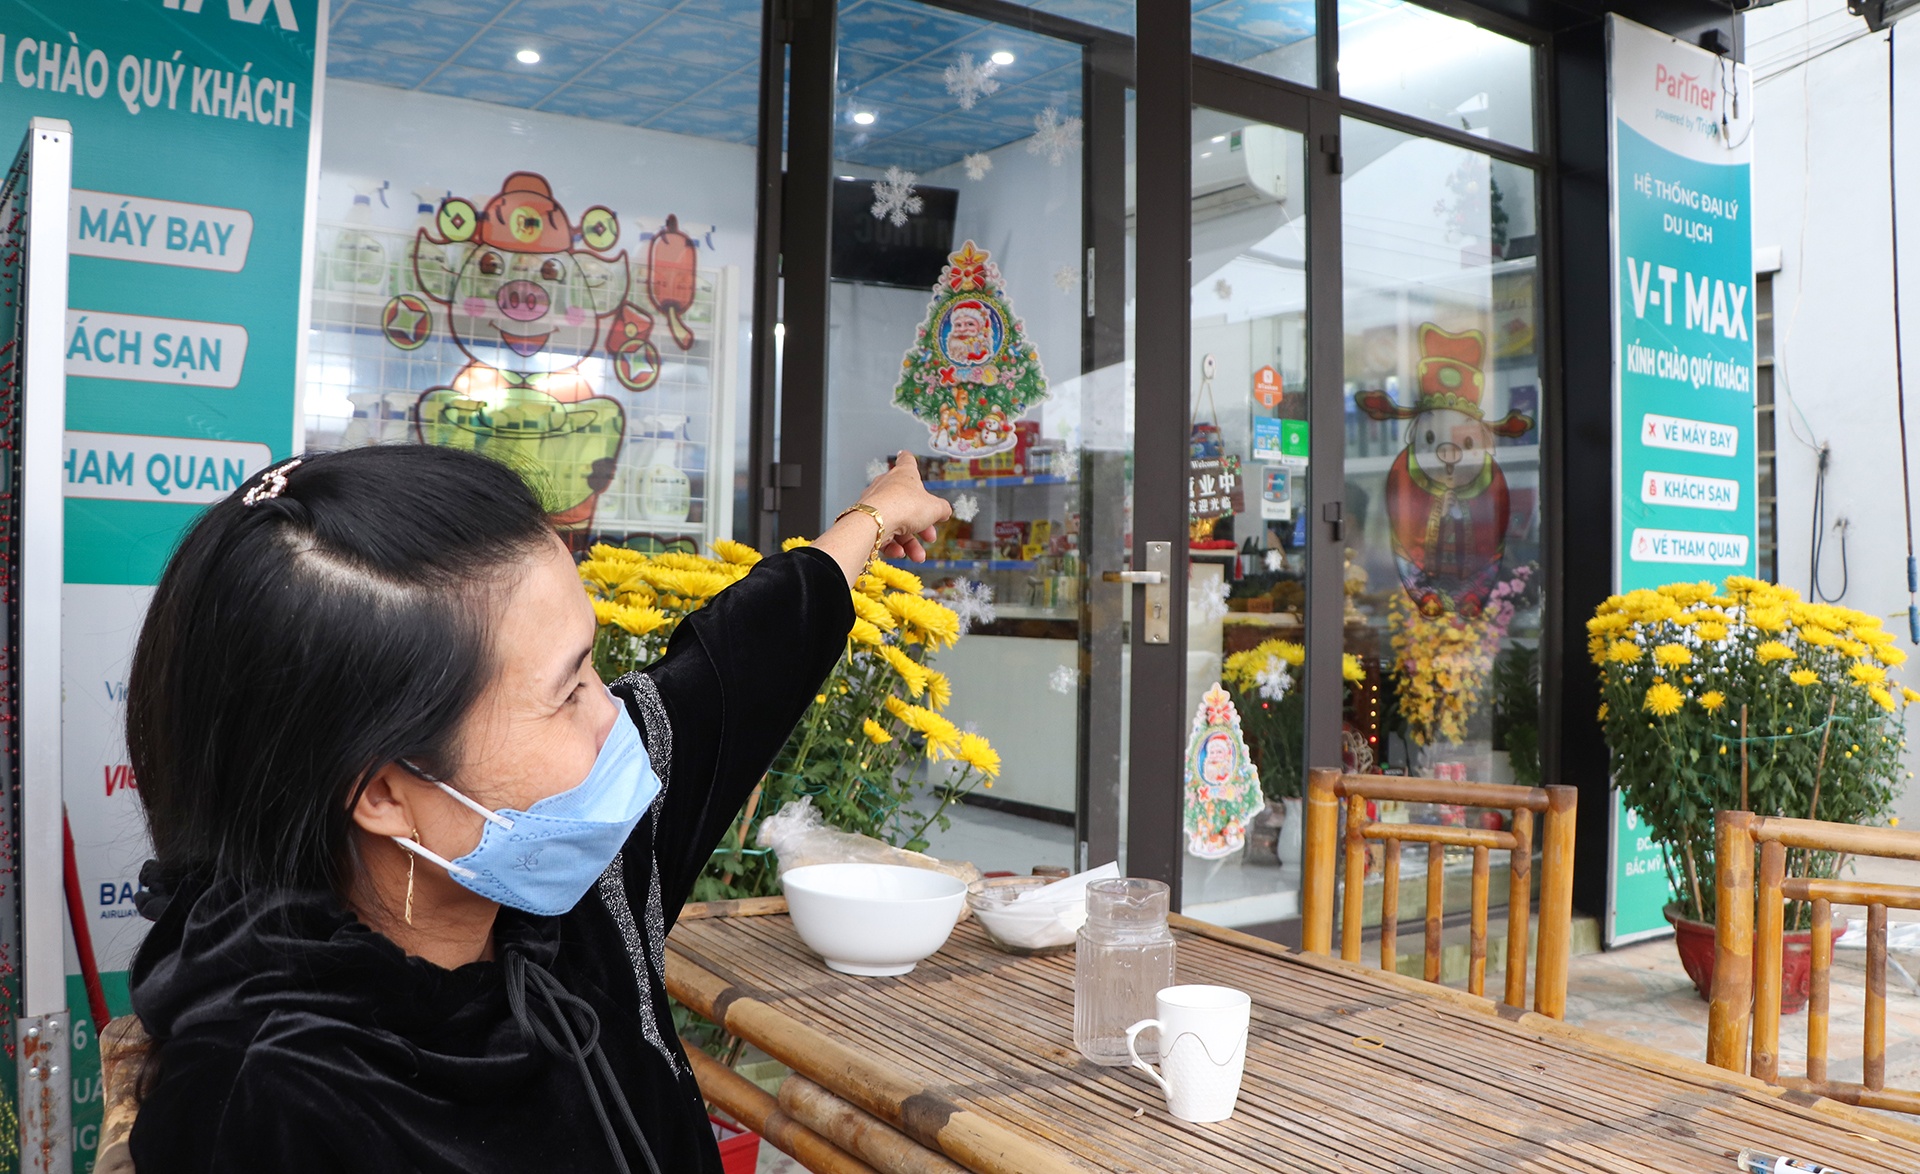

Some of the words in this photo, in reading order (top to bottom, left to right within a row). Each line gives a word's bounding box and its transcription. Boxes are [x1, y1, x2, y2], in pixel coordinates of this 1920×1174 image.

[15, 31, 109, 99] CHÀO
[117, 50, 185, 115] QUÝ
[190, 62, 296, 128] KHÁCH
[1655, 108, 1684, 126] powered
[1685, 116, 1694, 131] by
[1634, 172, 1652, 199] HỆ
[1654, 180, 1699, 210] THỐNG
[1701, 194, 1723, 219] ĐẠI
[1725, 199, 1739, 221] LÝ
[79, 201, 156, 247] MÁY
[166, 216, 235, 256] BAY
[1663, 213, 1683, 235] DU
[1685, 221, 1713, 244] LỊCH
[1627, 256, 1678, 326] V-T
[1685, 271, 1748, 342] MAX
[152, 333, 222, 379] SẠN
[1627, 338, 1655, 376] KÍNH
[1657, 345, 1688, 382] CHÀO
[1690, 353, 1712, 389] QUÝ
[1714, 357, 1749, 393] KHÁCH
[1663, 420, 1678, 441] VÉ
[1682, 423, 1707, 446] MÁY
[1710, 431, 1732, 448] BAY
[146, 452, 245, 497] QUAN
[1664, 478, 1705, 500] KHÁCH
[1708, 485, 1731, 507] SẠN
[1652, 534, 1668, 555] VÉ
[1671, 539, 1705, 557] THAM
[1708, 541, 1741, 561] QUAN
[100, 882, 142, 905] BA
